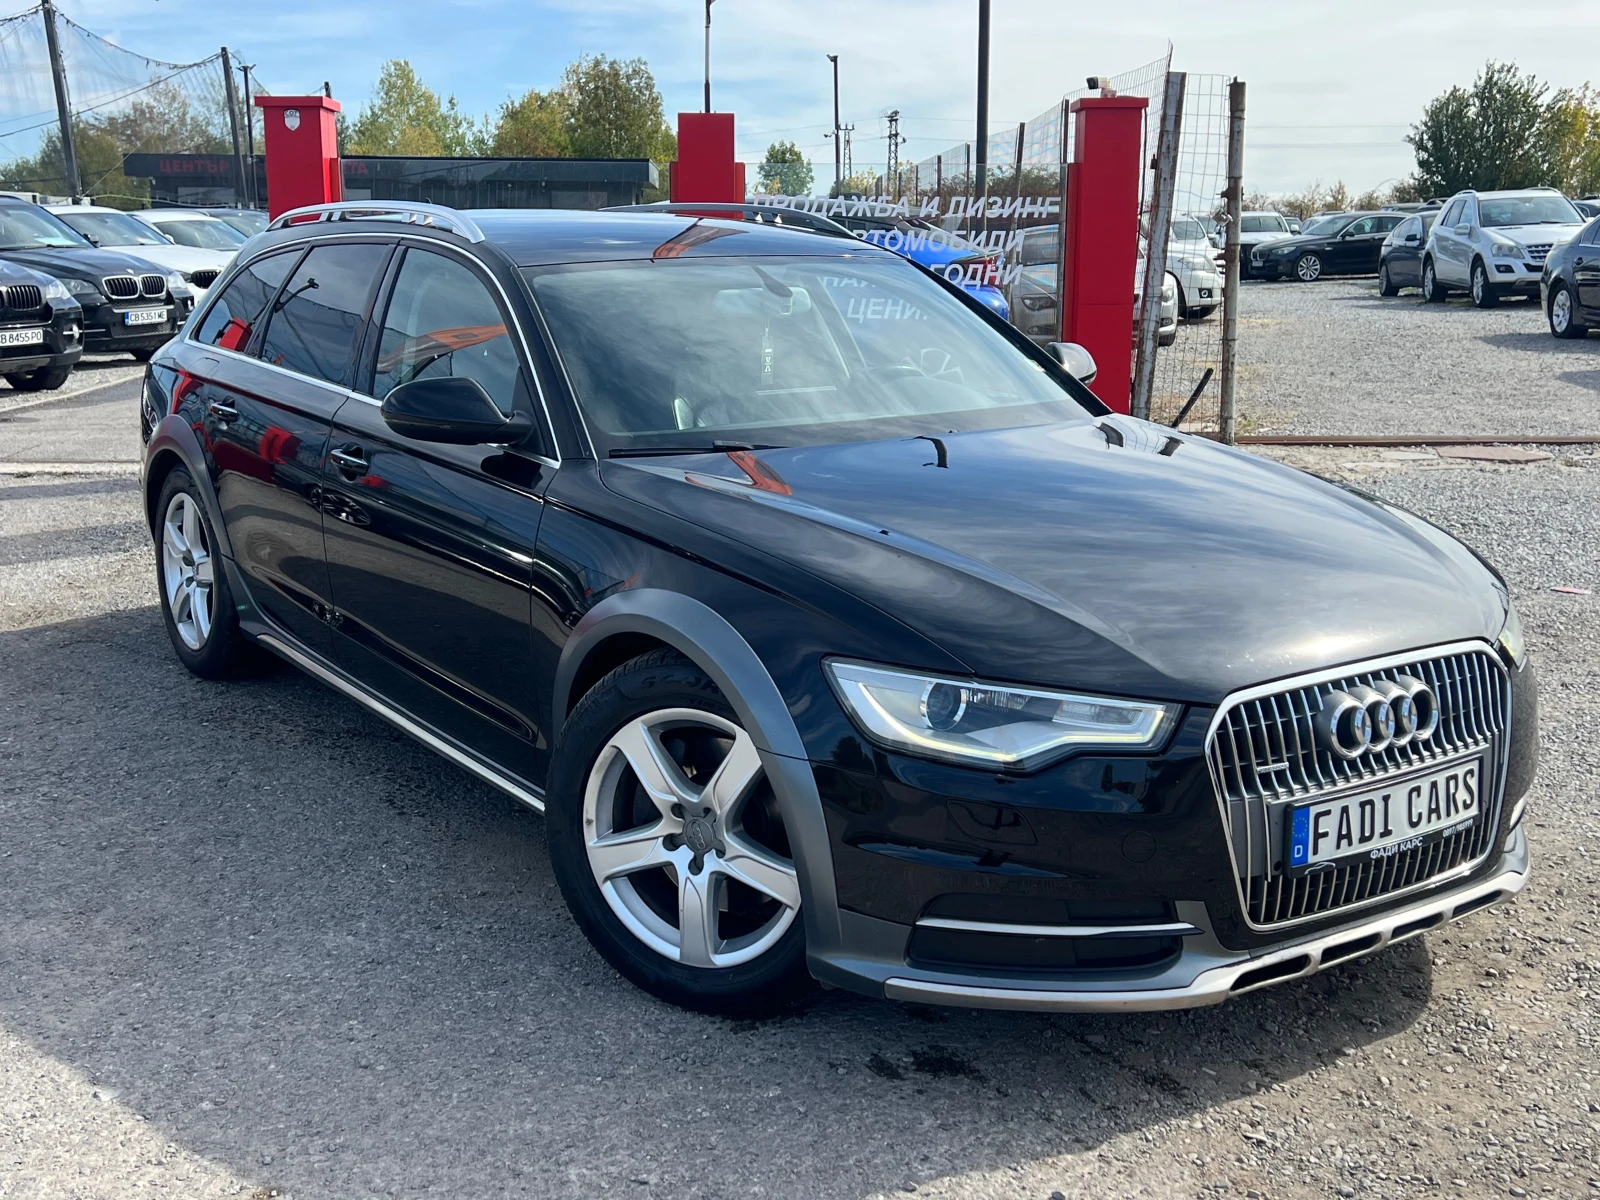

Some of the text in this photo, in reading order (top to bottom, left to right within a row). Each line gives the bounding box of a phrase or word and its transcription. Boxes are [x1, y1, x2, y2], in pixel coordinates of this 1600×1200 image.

[160, 160, 229, 175] ЦЕНТЪР
[752, 194, 910, 219] ПРОДАЖБА
[919, 196, 940, 217] И
[852, 230, 1025, 251] ТОМОБИЛИ
[8, 332, 30, 343] 8455
[1312, 767, 1475, 856] FADI CARS
[1293, 844, 1303, 858] D
[1370, 837, 1424, 859] ФАДИ КАРС
